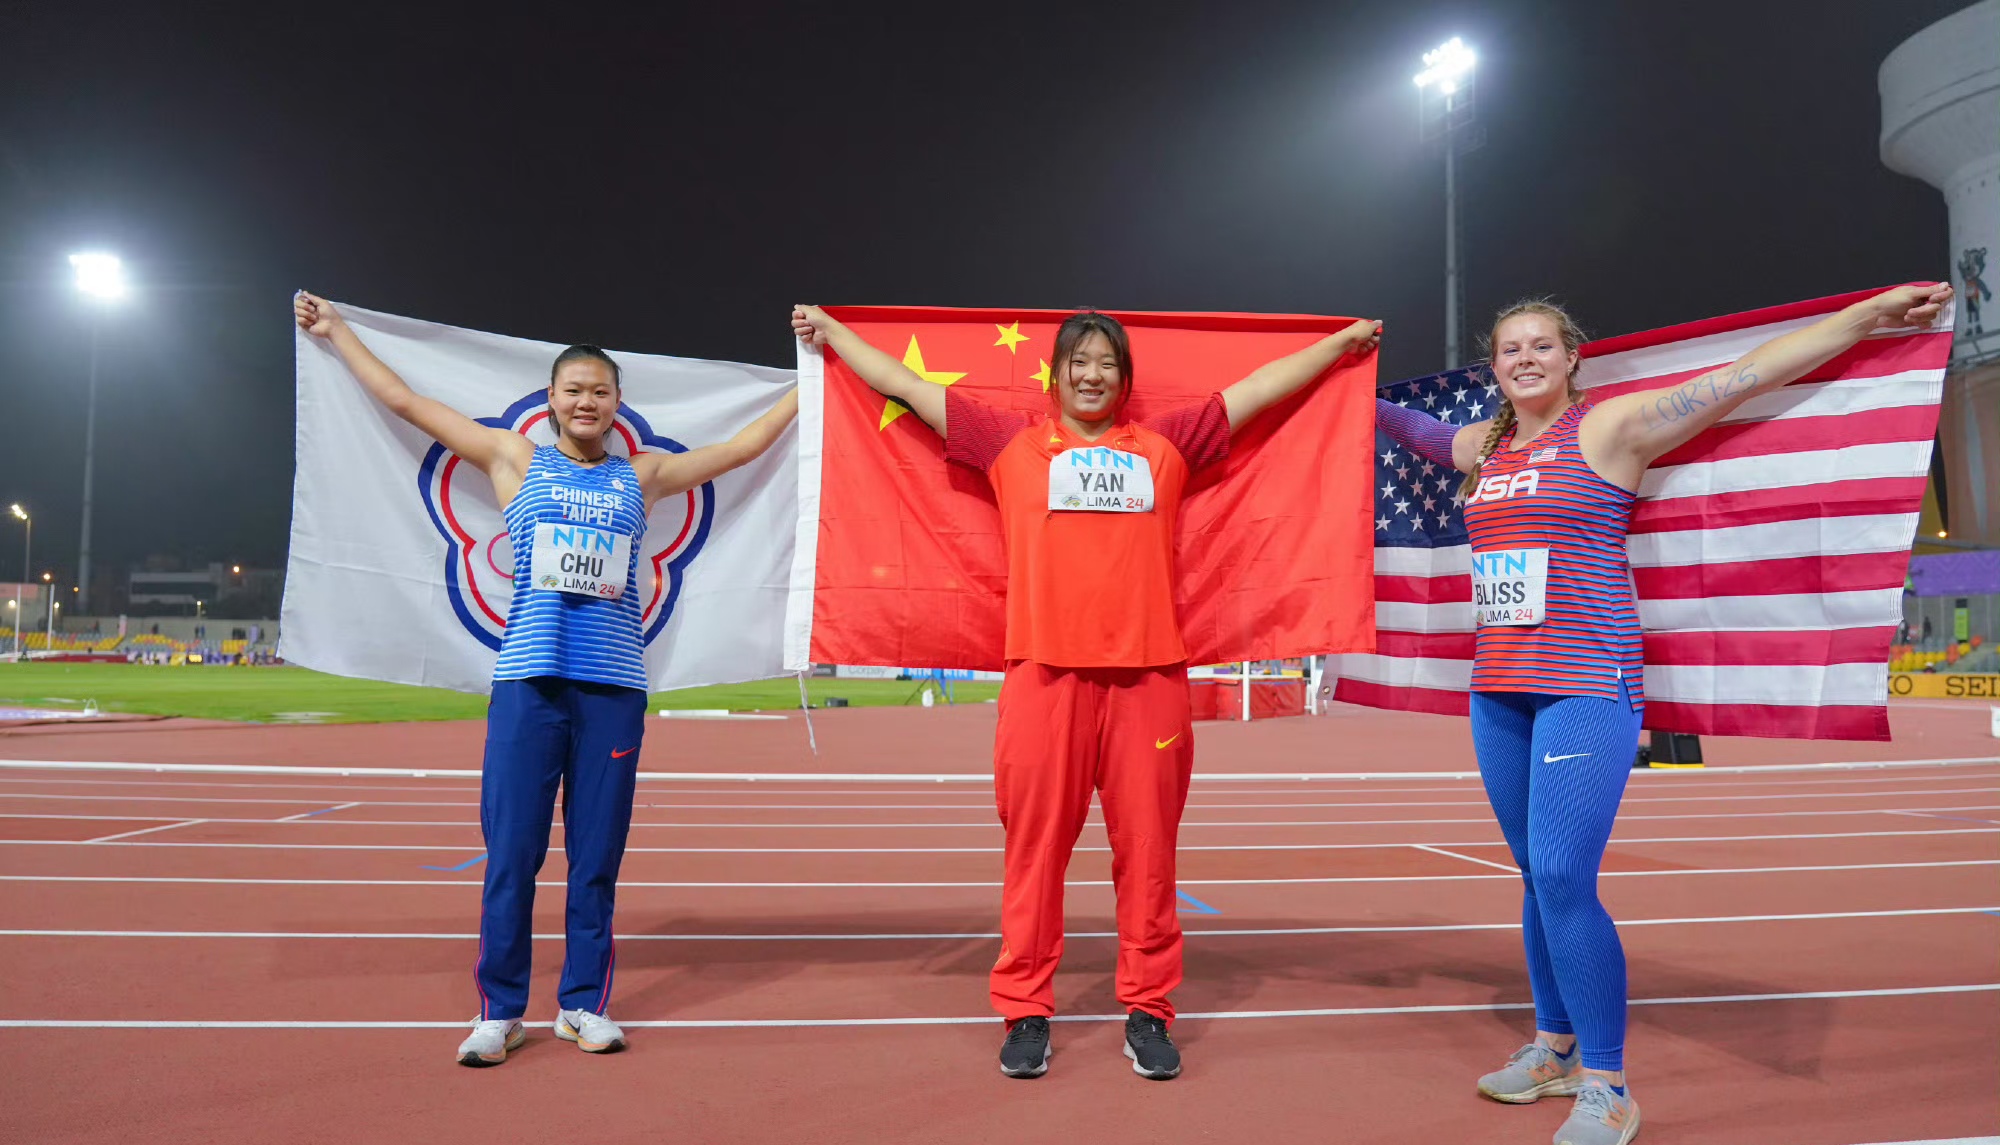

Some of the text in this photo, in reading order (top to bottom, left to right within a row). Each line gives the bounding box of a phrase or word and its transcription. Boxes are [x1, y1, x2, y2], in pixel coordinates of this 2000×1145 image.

[1071, 447, 1134, 471] NTN
[1079, 472, 1125, 492] YAN
[1466, 468, 1540, 504] USA
[551, 485, 625, 511] CHINESE
[1086, 496, 1145, 509] LIMA 24
[560, 502, 614, 526] TAIPEI
[553, 526, 615, 556] NTN
[560, 553, 604, 578] CHU
[1472, 551, 1527, 578] NTN
[563, 577, 616, 596] LIMA 24
[1475, 581, 1526, 605] BLISS
[1485, 608, 1534, 622] LIMA 24
